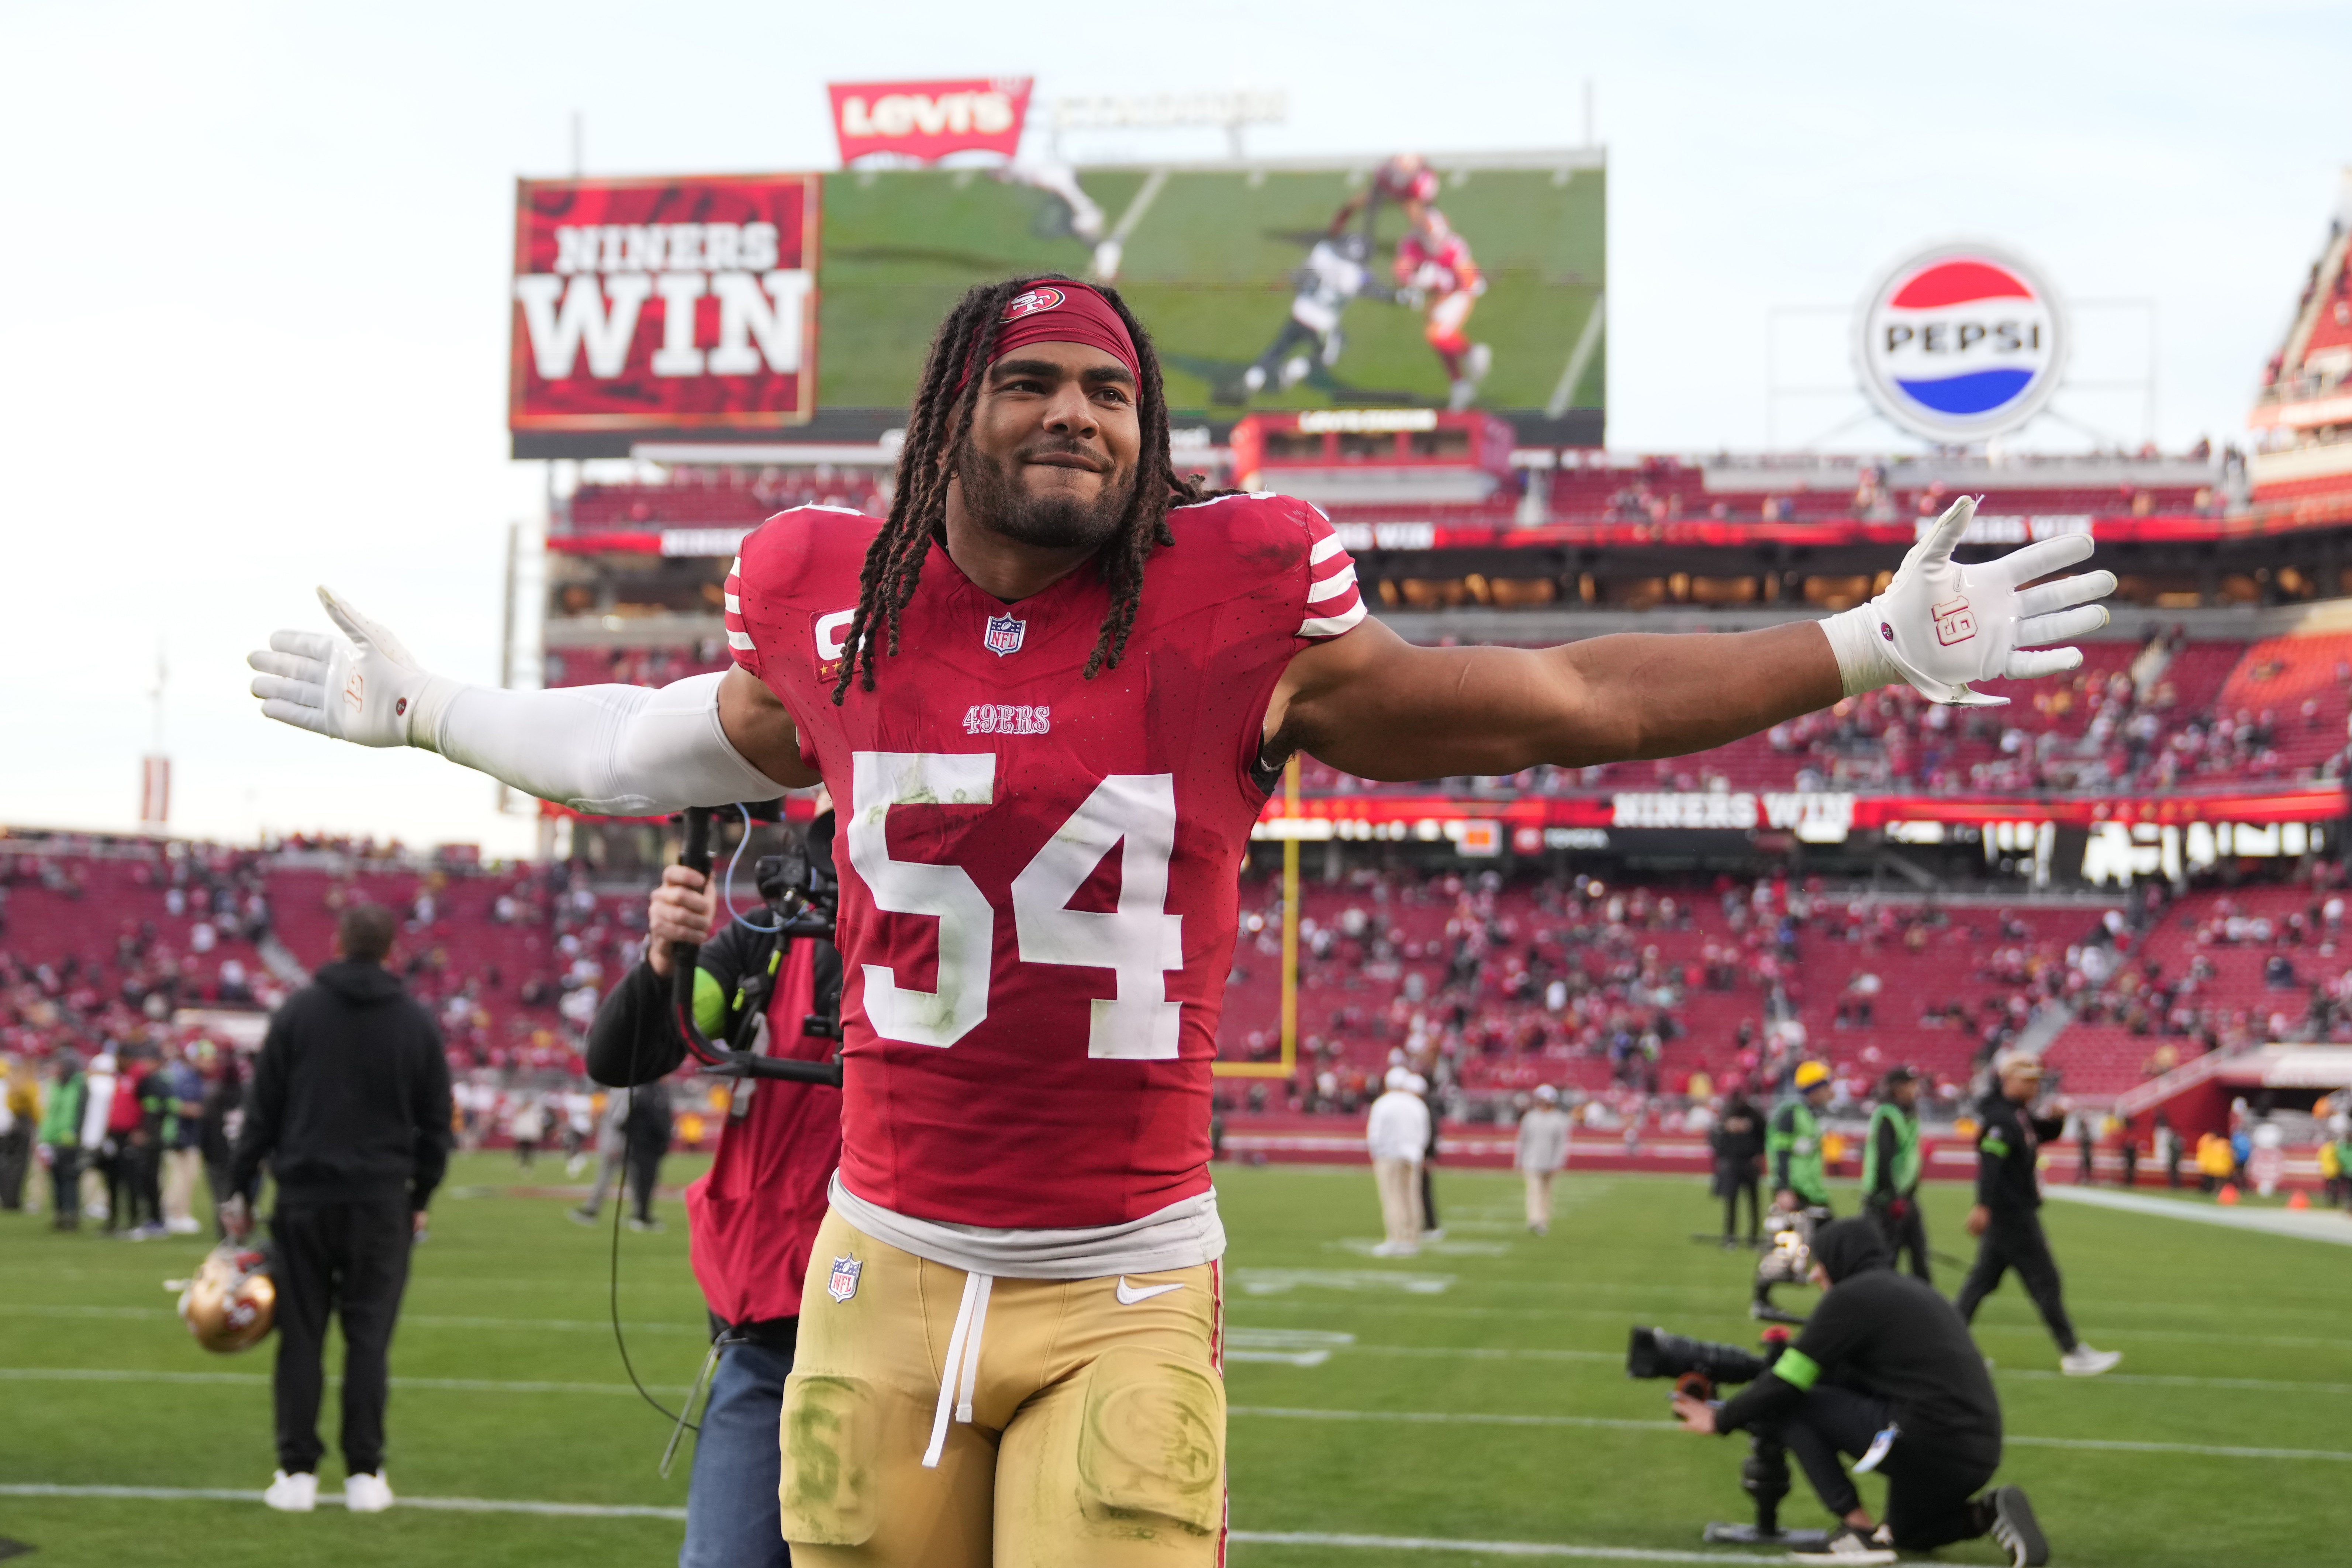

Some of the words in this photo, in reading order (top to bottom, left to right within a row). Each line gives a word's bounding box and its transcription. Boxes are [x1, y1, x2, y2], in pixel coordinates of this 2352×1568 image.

[555, 222, 779, 274] NINERS
[1011, 291, 1051, 313] SF
[517, 269, 812, 379] WIN
[1886, 322, 2040, 354] PEPSI
[1931, 595, 1978, 646] 19
[990, 631, 1016, 649] NFL
[962, 704, 1050, 734] 49ERS
[1612, 792, 1759, 829] NINERS
[1762, 792, 1856, 829] WIN
[847, 751, 1183, 1060] 54
[832, 1274, 851, 1293] NFL
